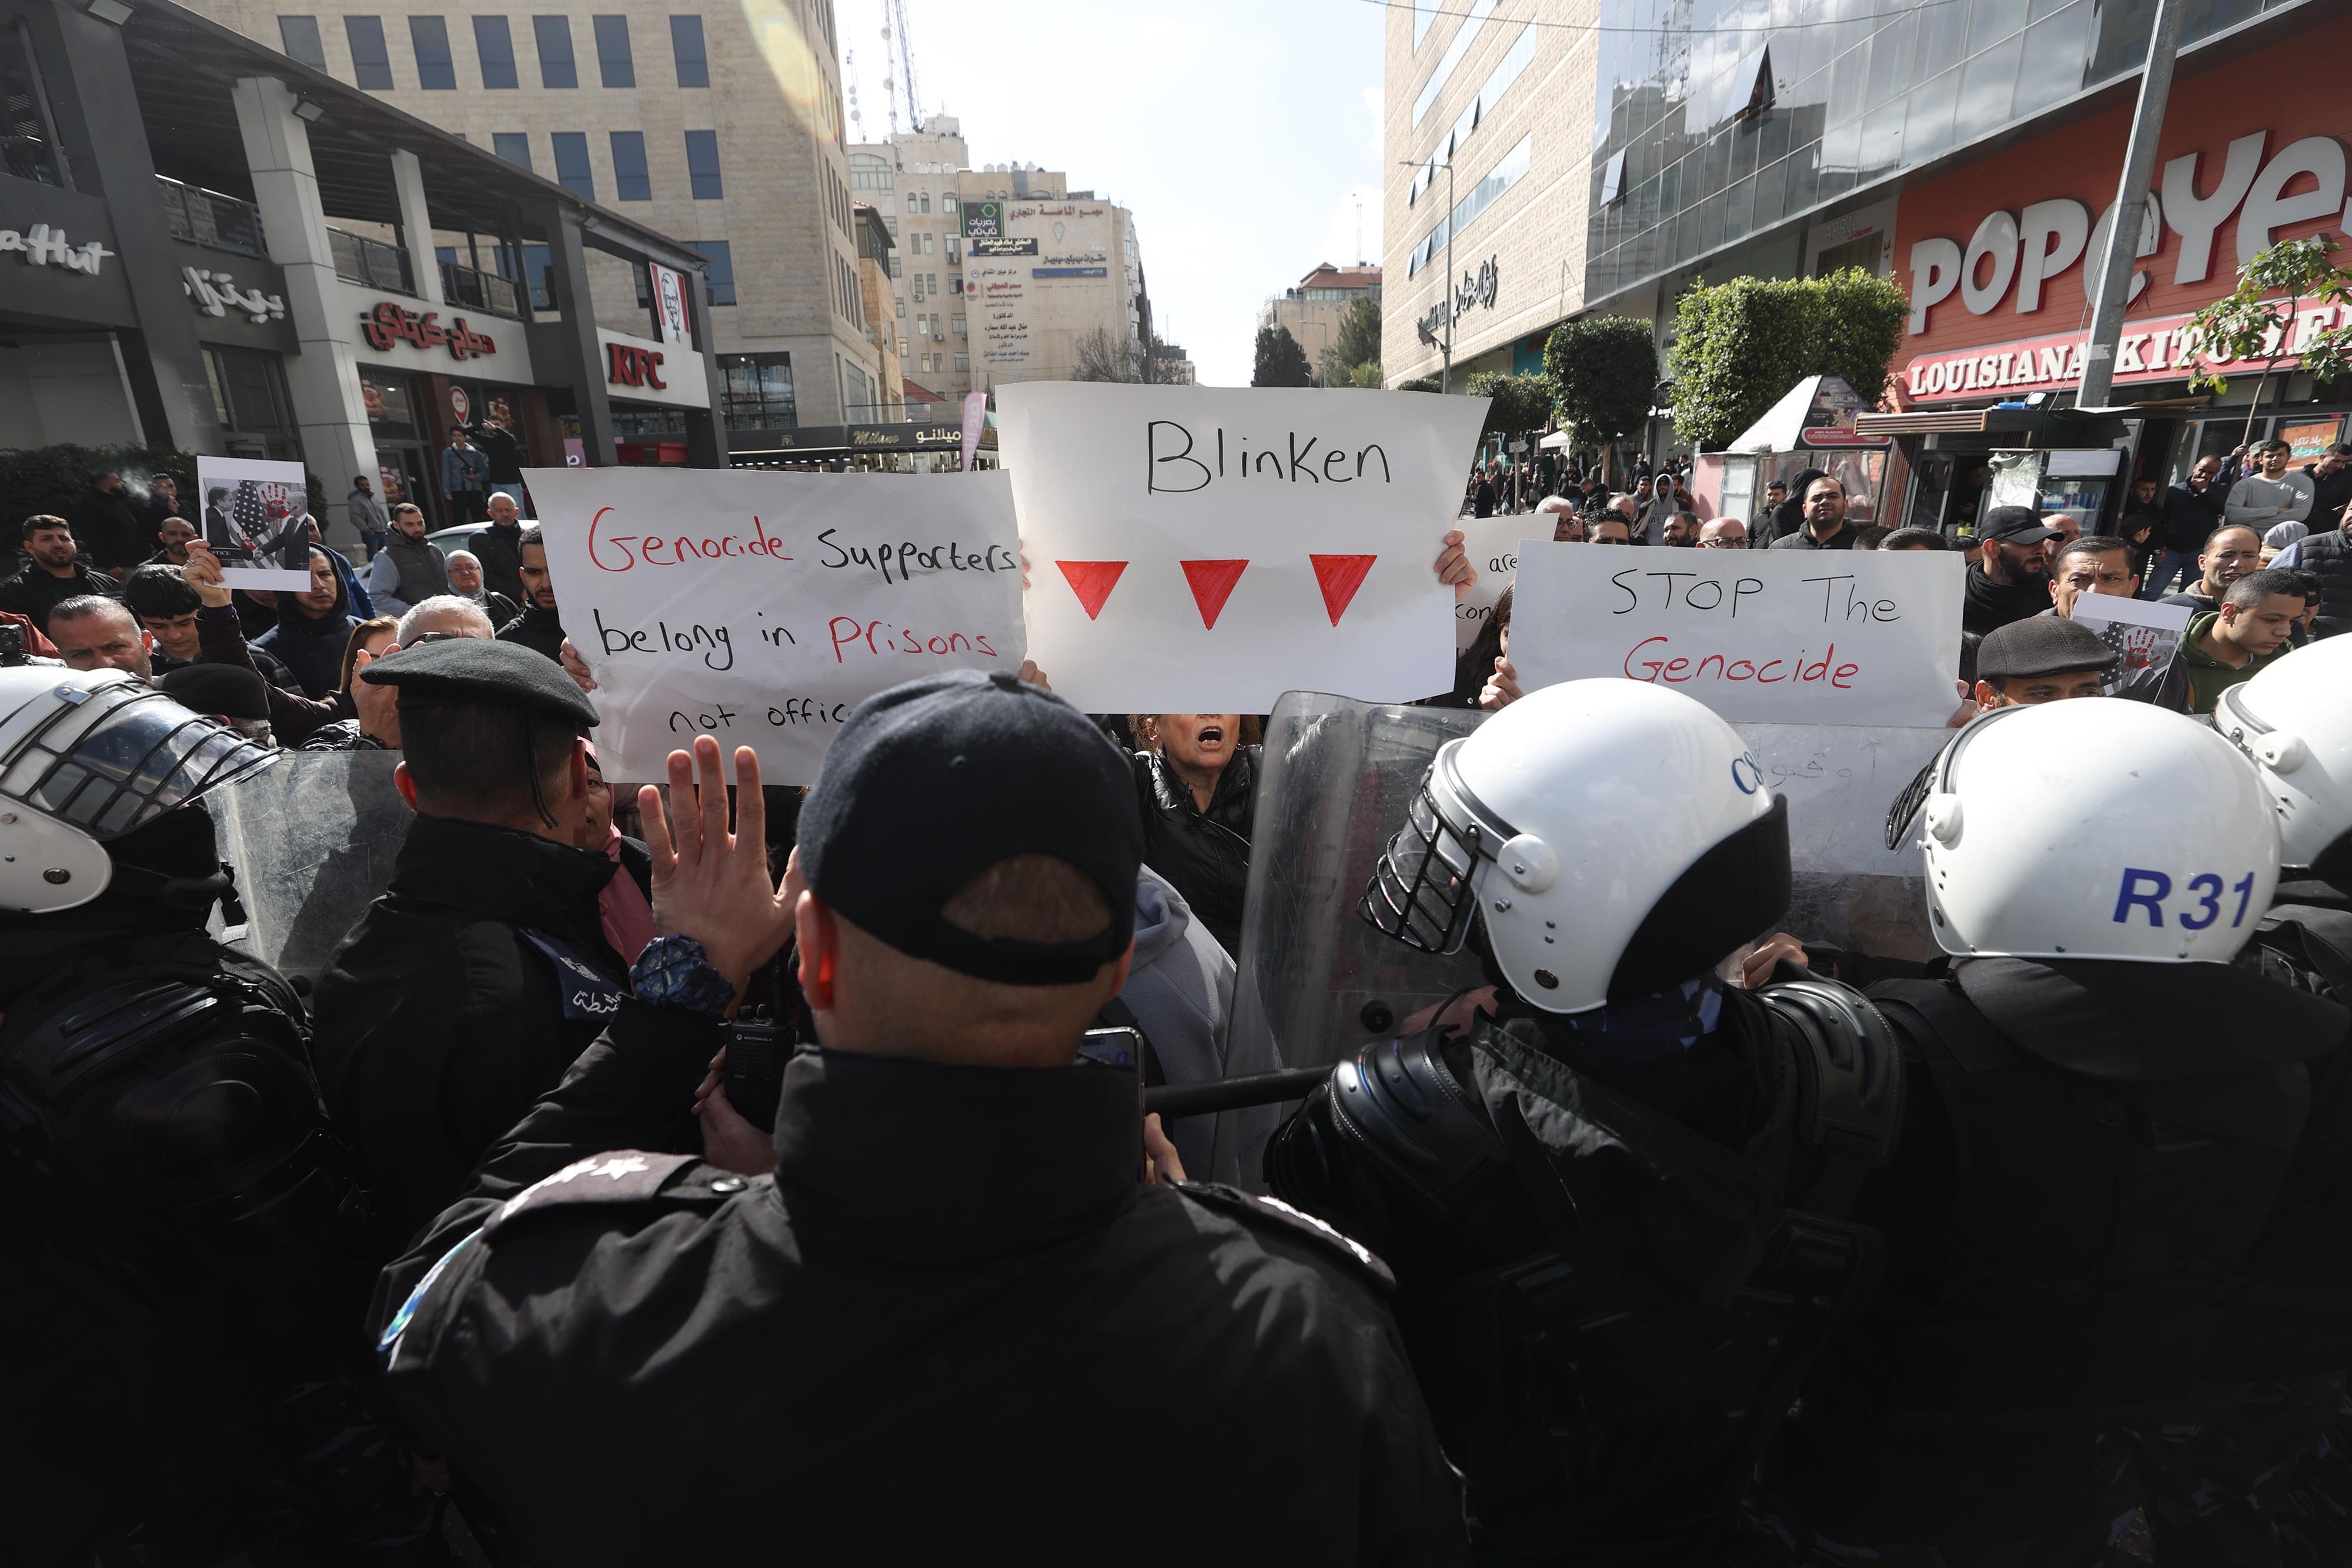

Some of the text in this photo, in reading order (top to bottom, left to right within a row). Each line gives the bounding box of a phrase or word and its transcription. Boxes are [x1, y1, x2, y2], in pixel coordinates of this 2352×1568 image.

[969, 218, 995, 227] بصريات
[1010, 208, 1035, 220] التجاري
[1080, 208, 1104, 218] مجمع
[1907, 129, 2352, 336] POPeYe
[183, 266, 285, 325] بيتزا
[360, 302, 496, 361] دجاج كنتاكي
[606, 342, 667, 390] KFC
[853, 430, 900, 446] Milano
[915, 427, 962, 444] ميلانو
[1148, 419, 1391, 496] Blinken
[588, 506, 1018, 586] Genocide Supporters
[1489, 554, 1518, 573] are
[1455, 603, 1492, 620] con
[1611, 567, 1902, 624] STOP The
[593, 607, 734, 671] belong
[758, 611, 797, 647] in
[1623, 635, 1860, 690] Genocide
[667, 697, 853, 734] not offic
[572, 989, 621, 1014] شرطة
